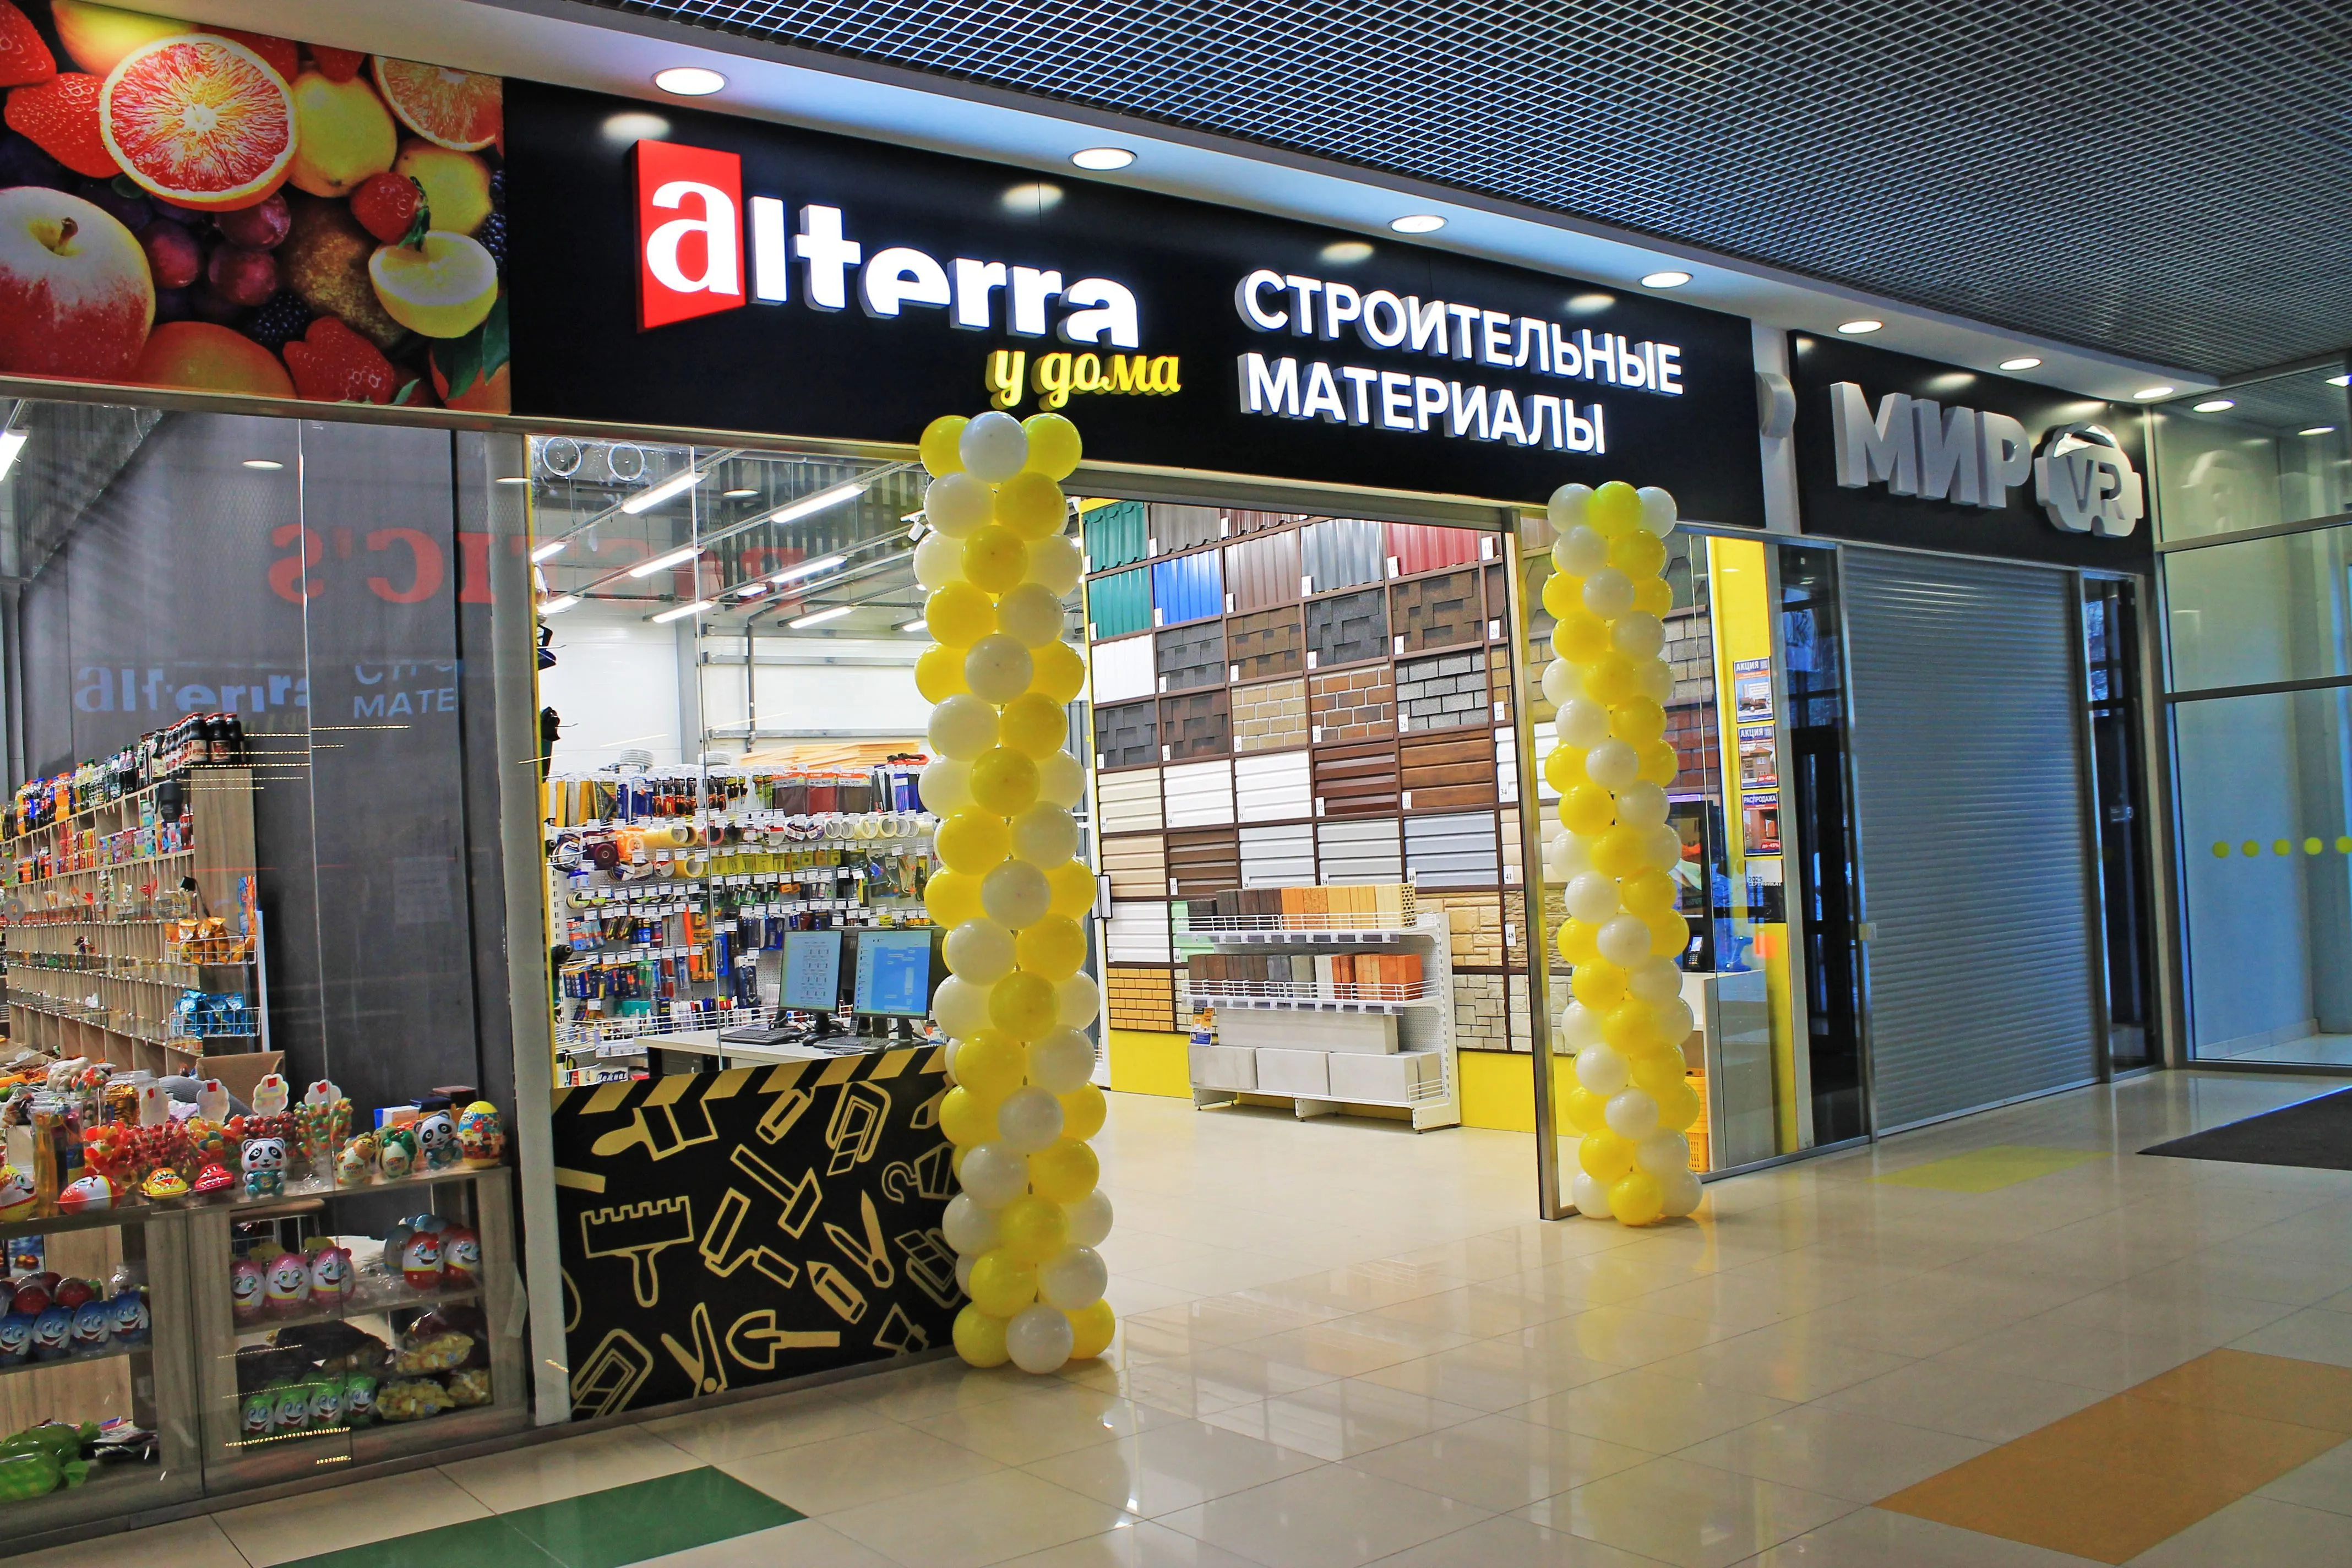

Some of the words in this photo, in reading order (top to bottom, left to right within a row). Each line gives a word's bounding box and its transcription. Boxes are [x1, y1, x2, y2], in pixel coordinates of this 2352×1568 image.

[645, 179, 1140, 349] alterra
[1238, 269, 1684, 395] СТРОИТЕЛЬНЫЕ
[989, 348, 1026, 409] у
[1035, 351, 1182, 411] дома
[1241, 351, 1606, 455] МАТЕРИАЛЫ
[1830, 381, 2032, 509] МИР
[1736, 661, 1759, 671] АКЦИЯ
[1740, 728, 1763, 738] АКЦИЯ
[1744, 795, 1776, 803] РАСПРОДАЖА
